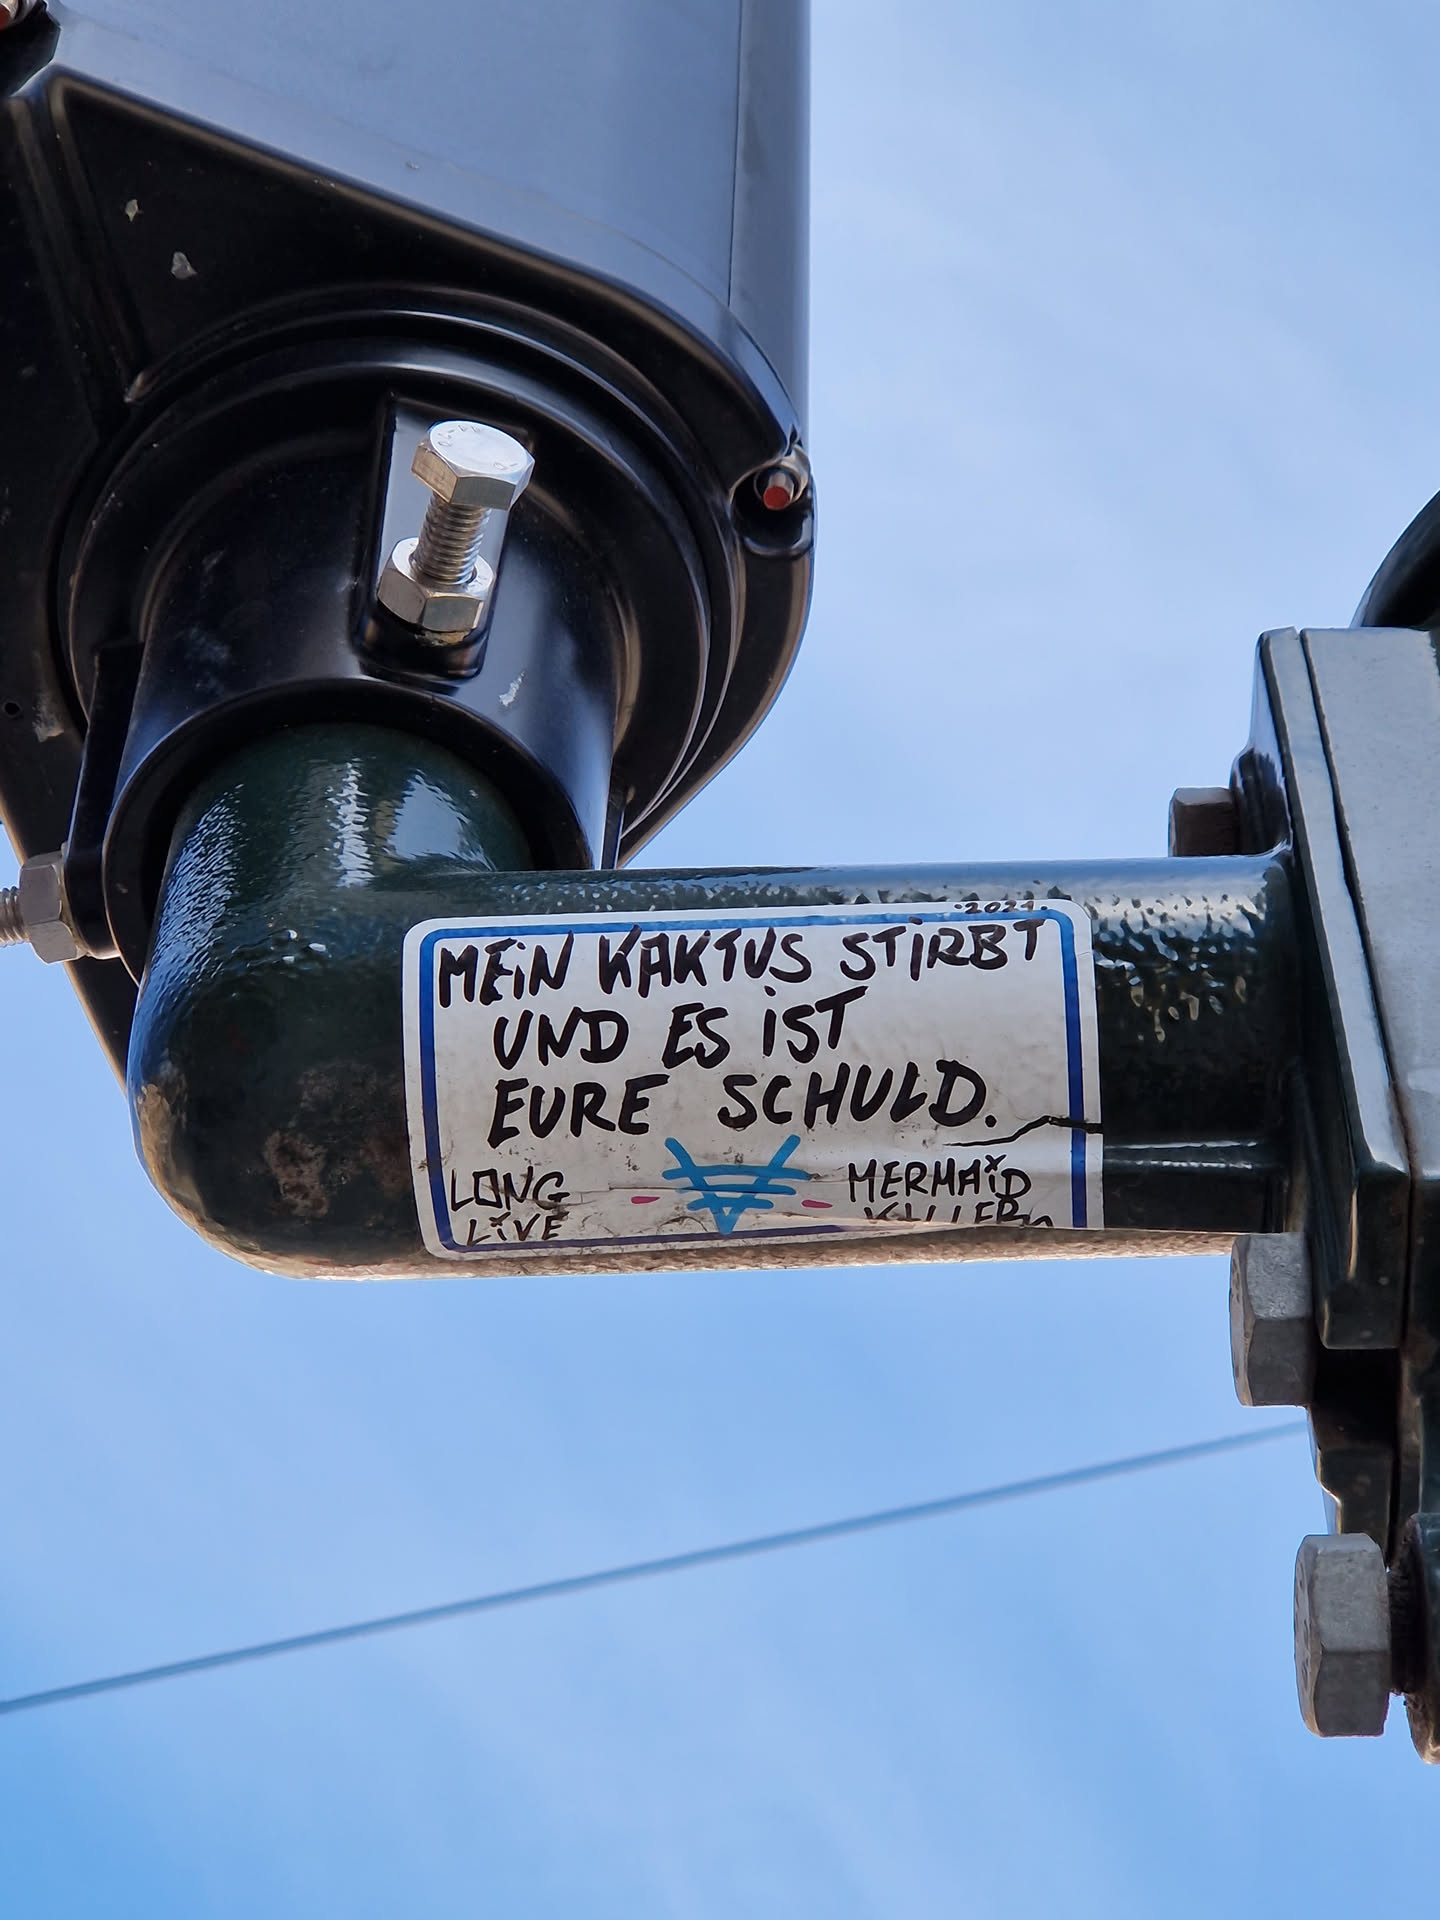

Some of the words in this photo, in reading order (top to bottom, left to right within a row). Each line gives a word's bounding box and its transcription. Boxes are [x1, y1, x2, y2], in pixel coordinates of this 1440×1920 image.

[599, 925, 812, 998] KAKTUS
[493, 1010, 629, 1070] UND
[661, 1002, 730, 1069] ES
[487, 1072, 670, 1149] EURE
[717, 1059, 997, 1131] SCHULD.
[450, 1166, 570, 1211] LONG
